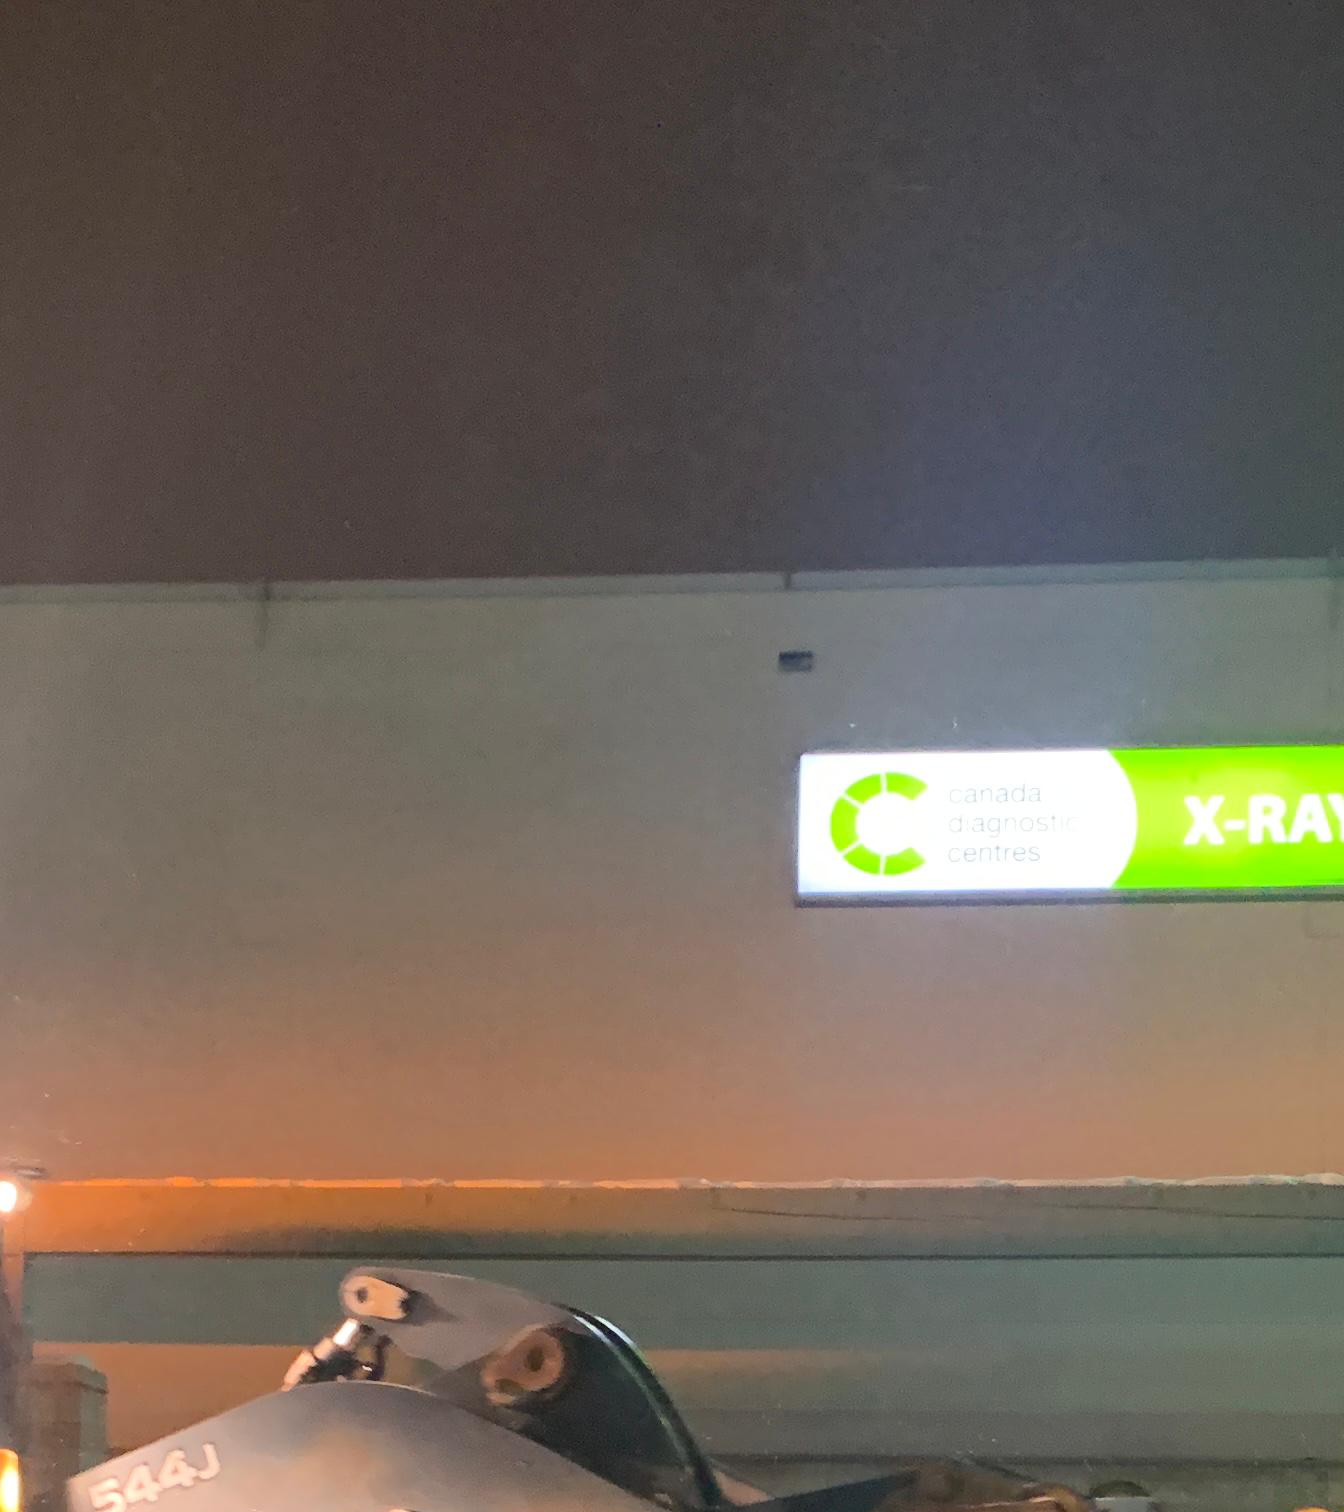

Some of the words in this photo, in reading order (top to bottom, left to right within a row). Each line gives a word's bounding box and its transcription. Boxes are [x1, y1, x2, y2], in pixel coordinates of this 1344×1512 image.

[948, 783, 1042, 804] canada
[948, 813, 1080, 838] diagnostic
[947, 845, 1042, 863] centres
